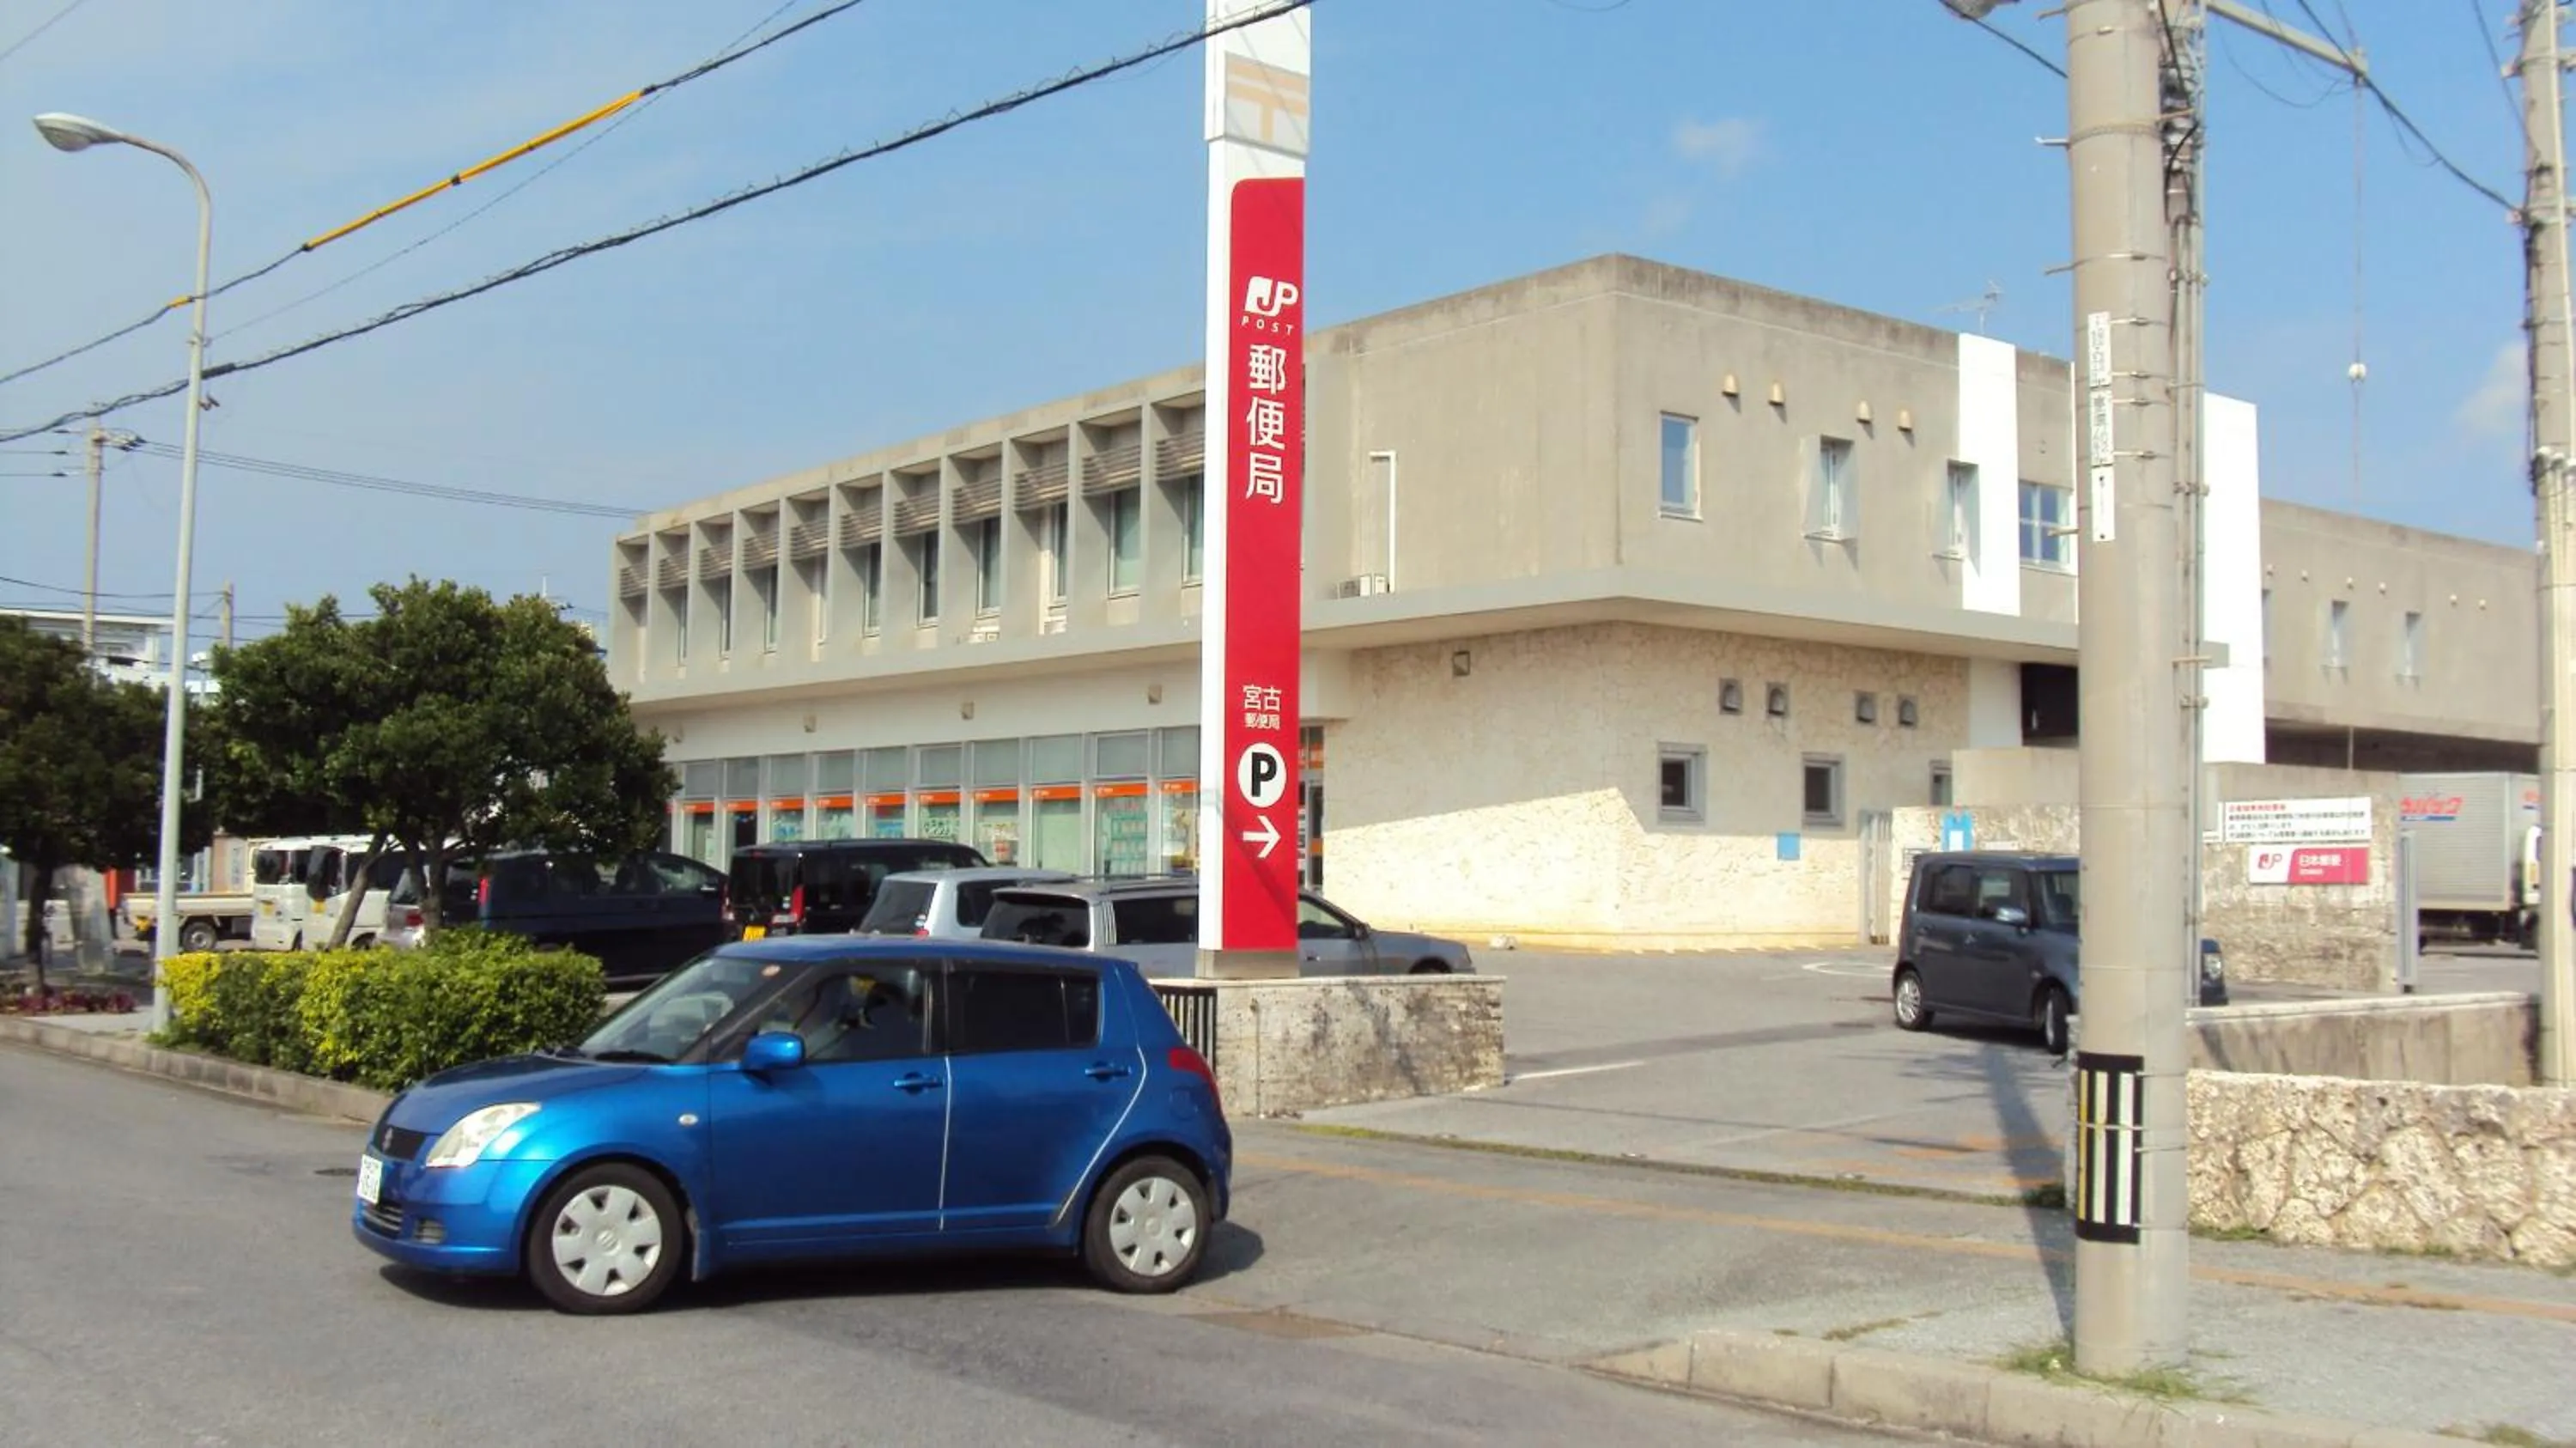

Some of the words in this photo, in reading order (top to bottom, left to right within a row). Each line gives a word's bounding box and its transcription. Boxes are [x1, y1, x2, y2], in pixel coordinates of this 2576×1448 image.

[1241, 315, 1294, 336] POST
[1246, 344, 1287, 504] 郵便局
[1242, 684, 1282, 711] 宮古
[1244, 712, 1280, 730] 郵便局
[1251, 751, 1278, 797] P
